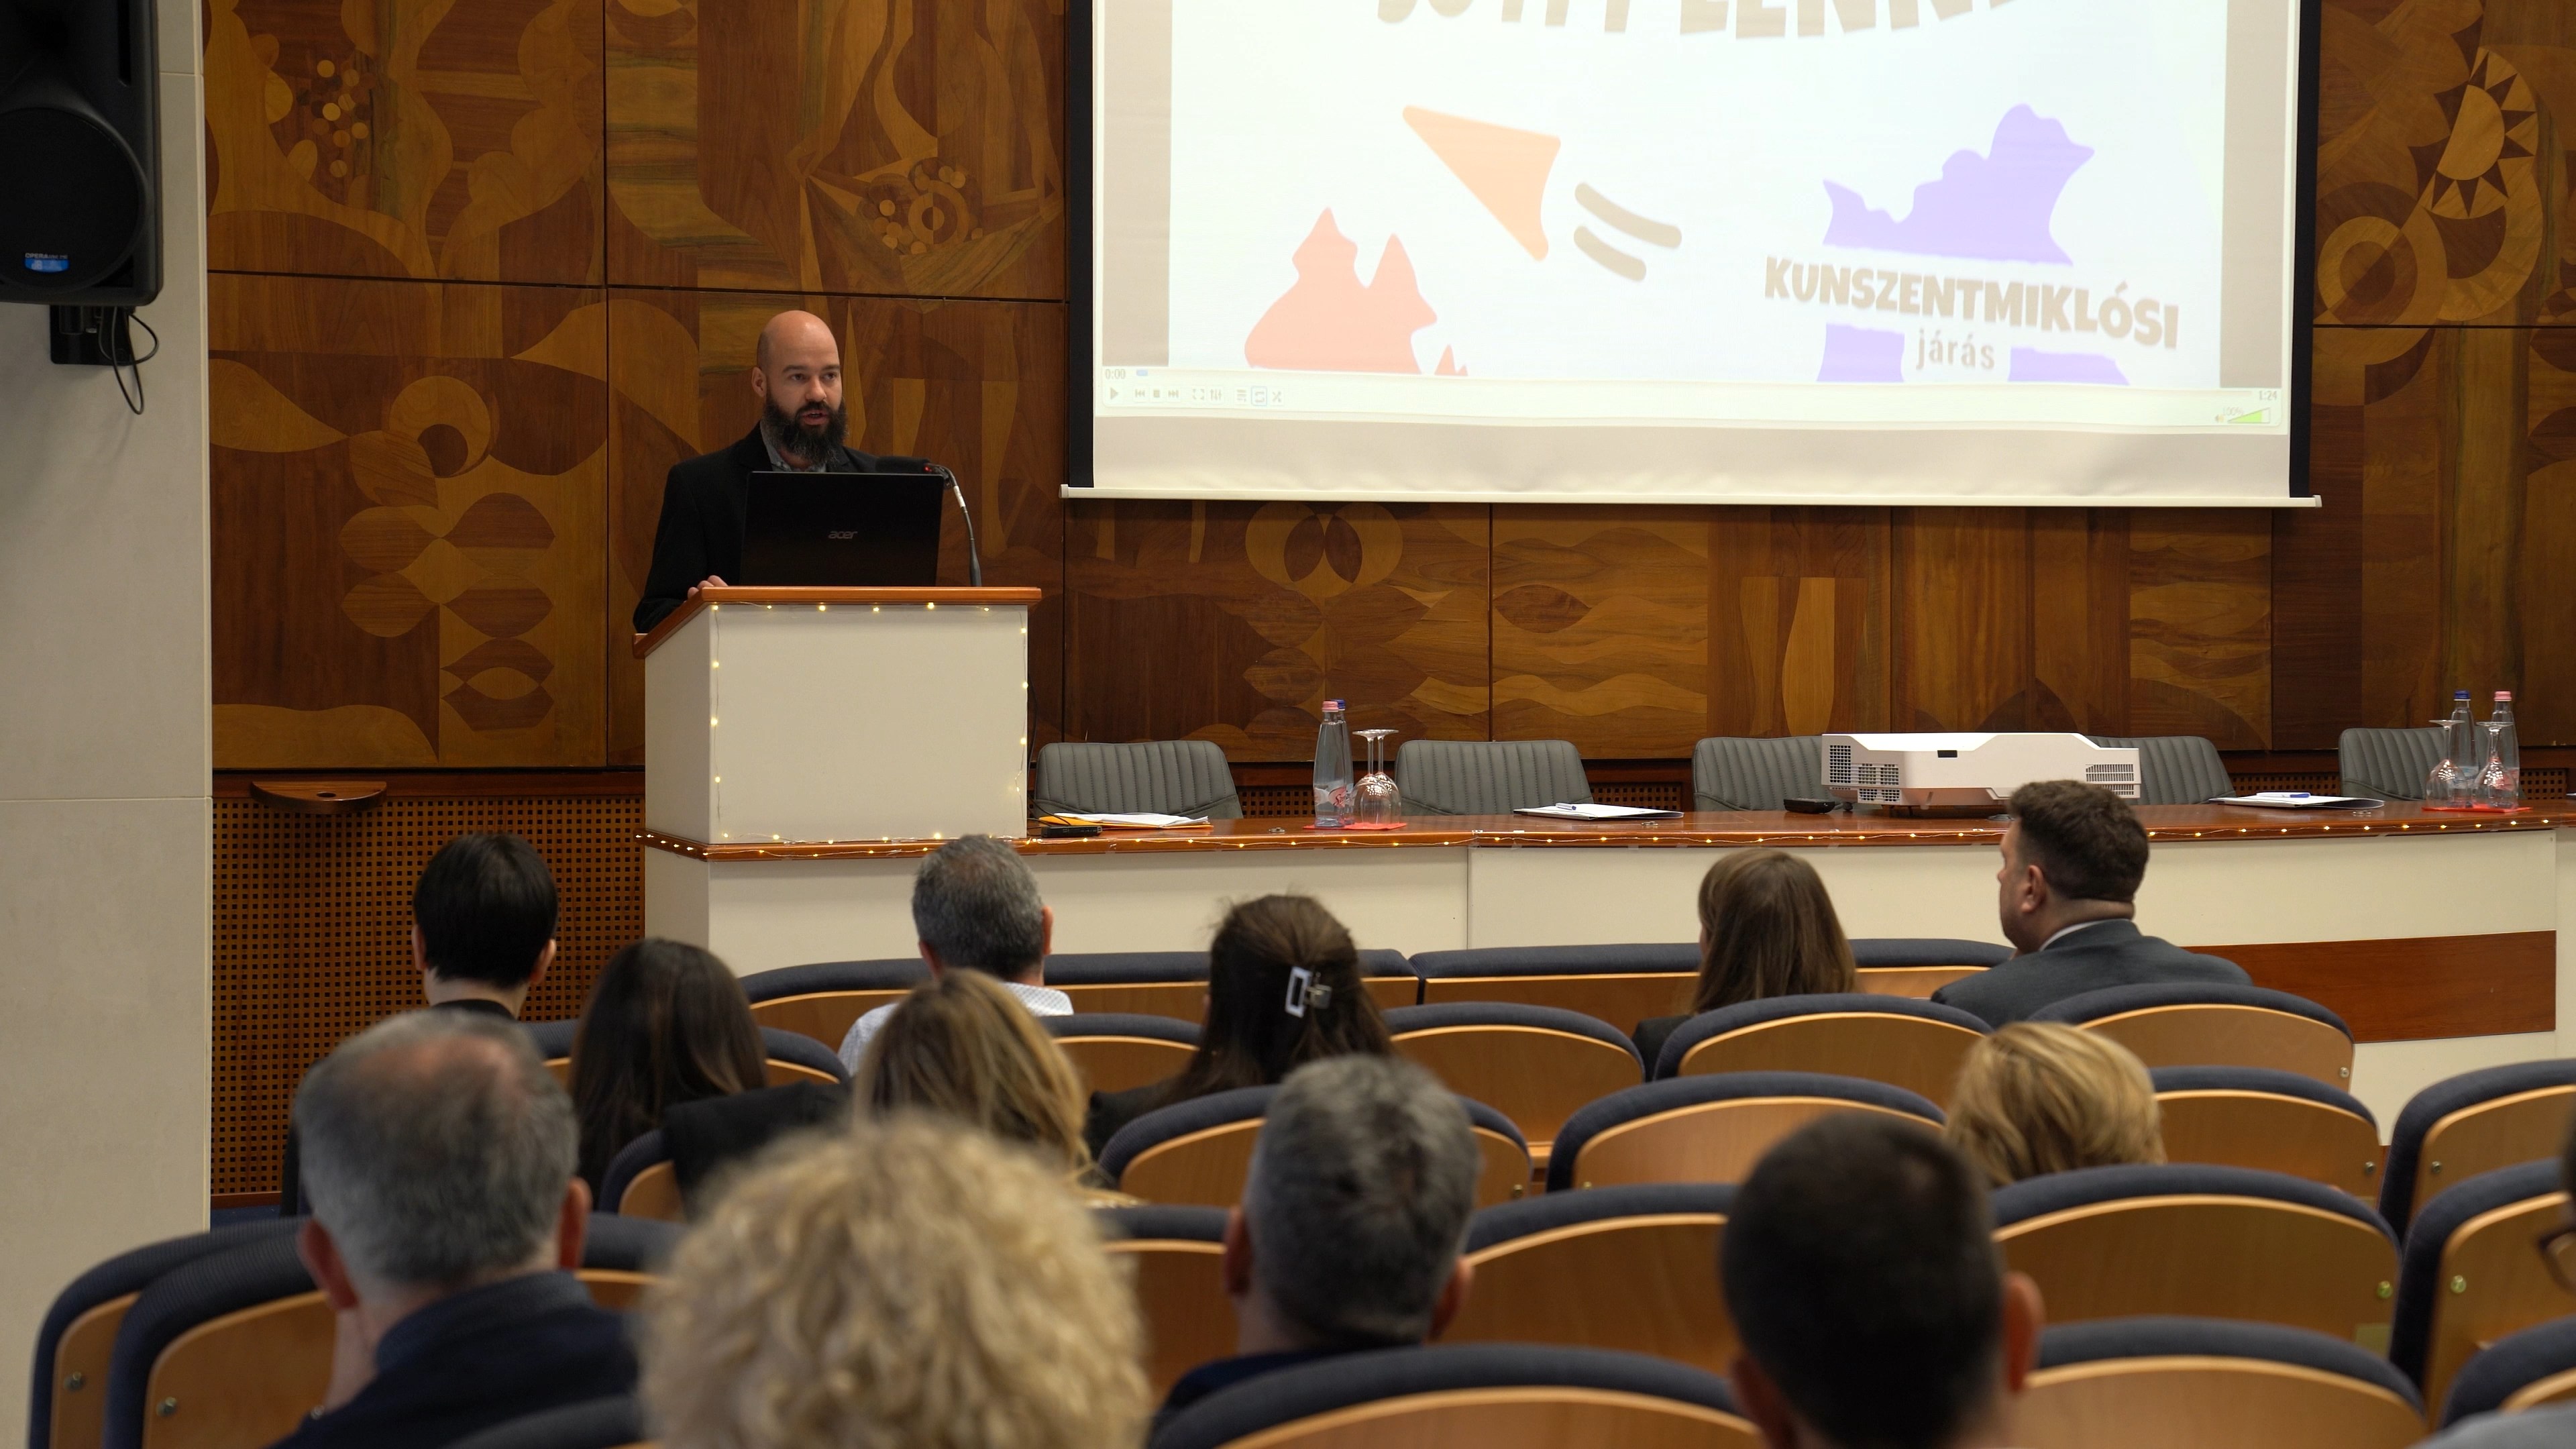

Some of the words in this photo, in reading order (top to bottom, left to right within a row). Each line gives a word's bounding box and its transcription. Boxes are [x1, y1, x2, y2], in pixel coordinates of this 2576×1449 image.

[1764, 256, 2179, 350] KUNSZENTMIKLÓSI
[1915, 327, 1995, 371] járás
[1105, 368, 1126, 380] 0:00
[2258, 390, 2278, 401] 1:24
[828, 531, 858, 539] acer
